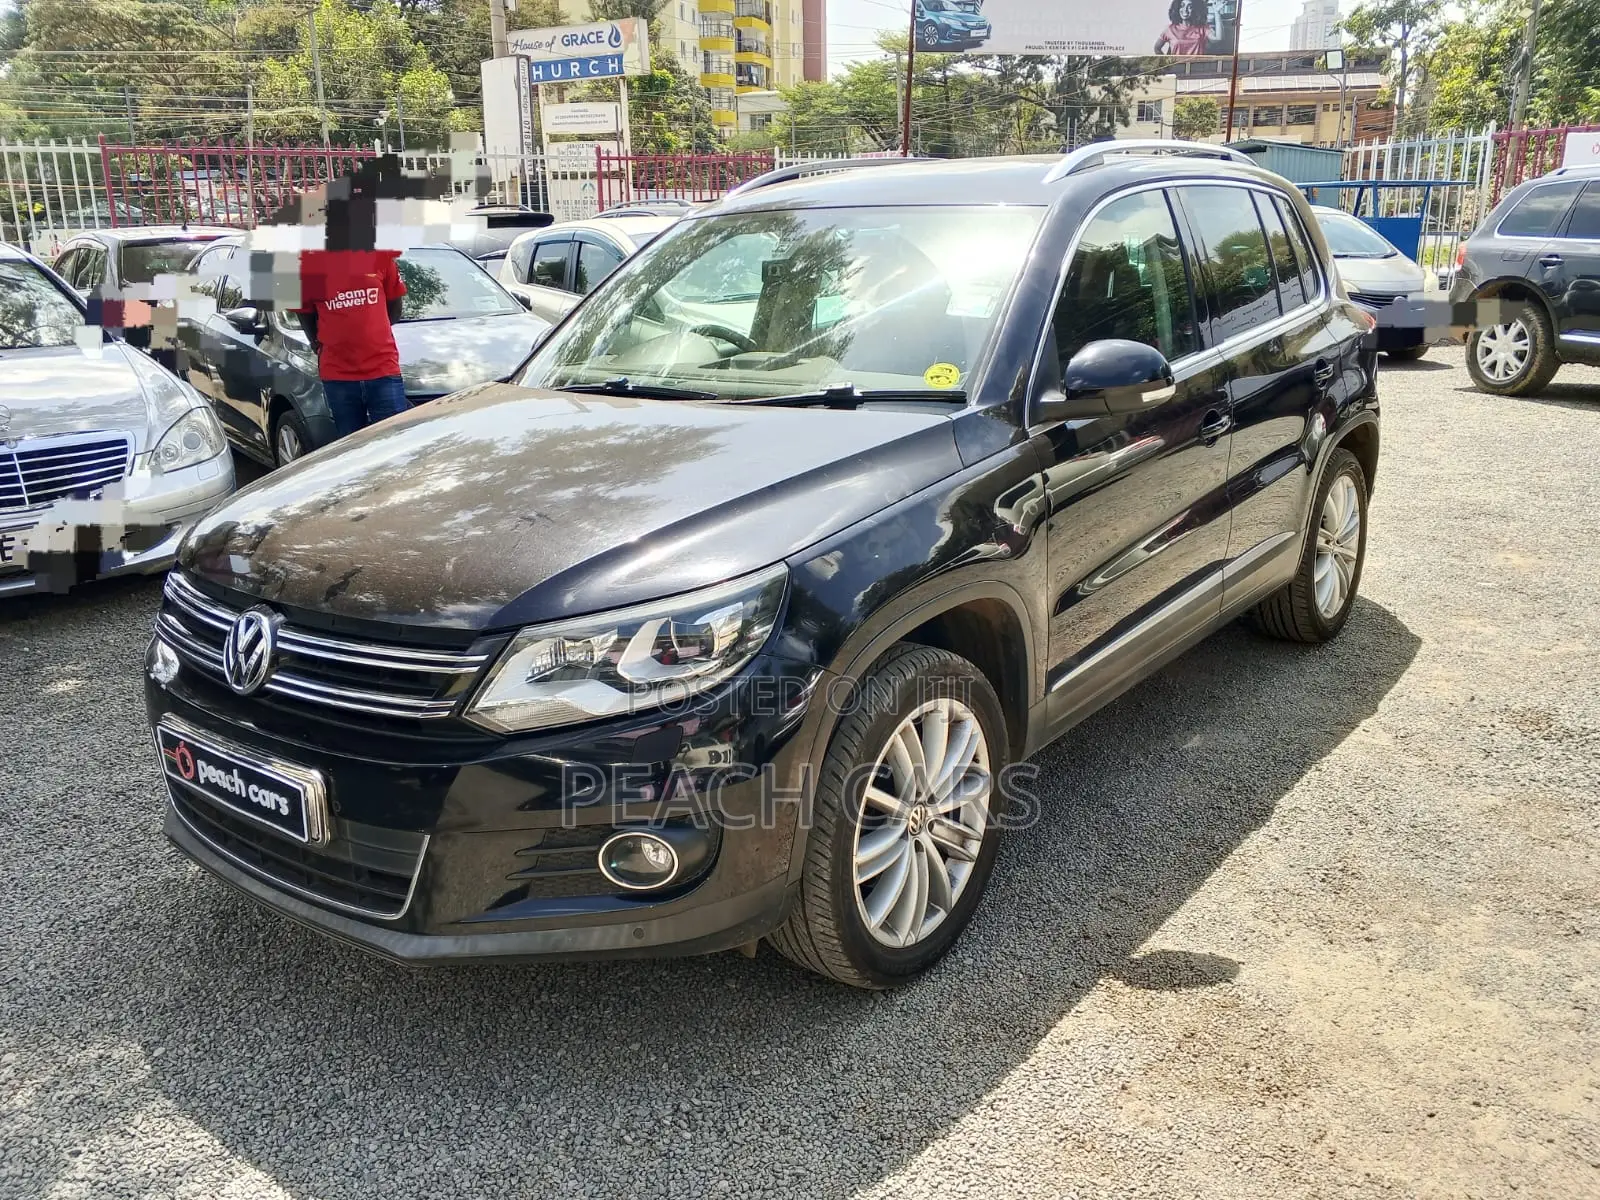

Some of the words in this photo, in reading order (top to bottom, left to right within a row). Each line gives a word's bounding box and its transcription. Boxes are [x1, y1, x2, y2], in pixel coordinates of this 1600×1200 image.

[511, 38, 543, 53] House
[545, 35, 556, 52] of
[561, 30, 605, 47] GRACE
[532, 58, 619, 81] HURCH
[335, 289, 366, 301] eam
[197, 759, 246, 798] peach
[248, 782, 290, 816] cars
